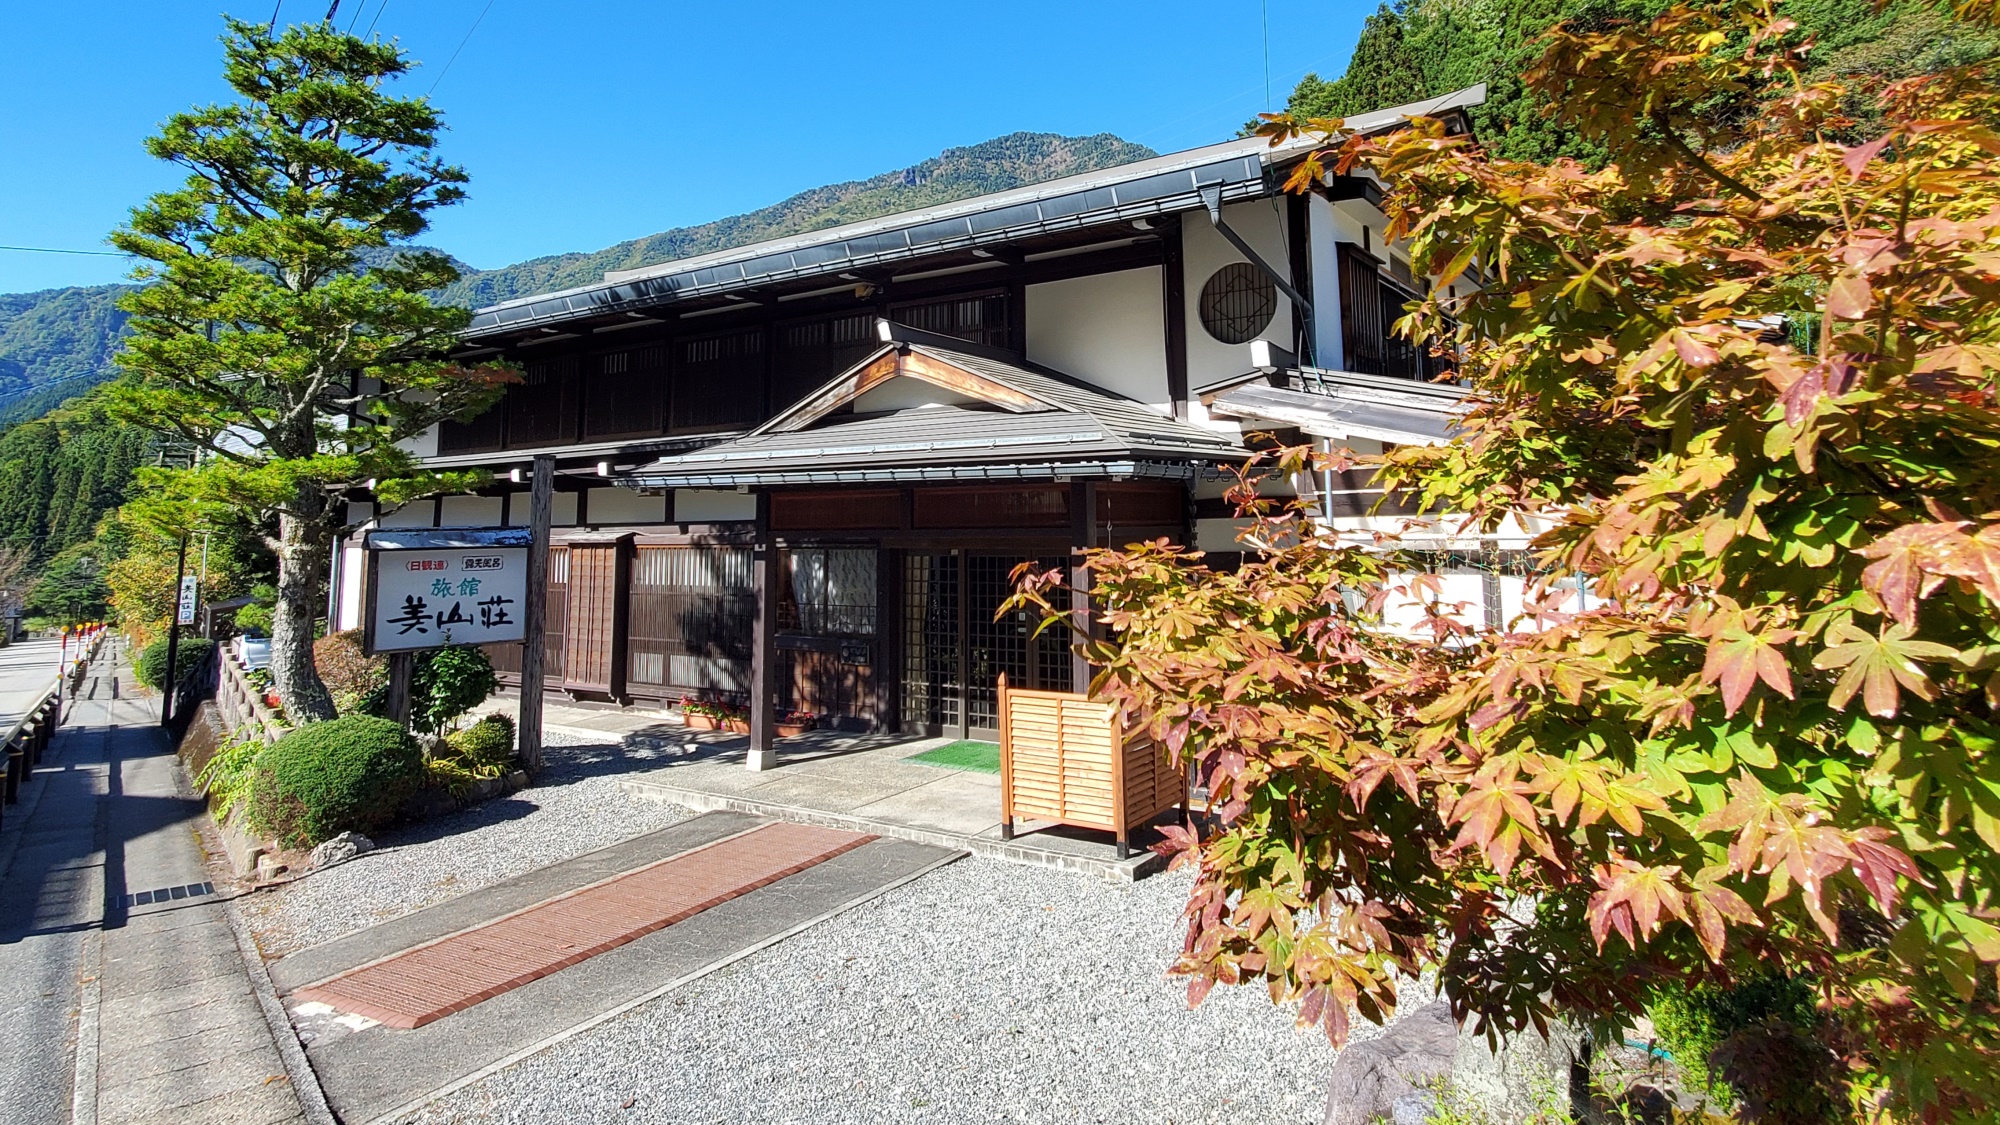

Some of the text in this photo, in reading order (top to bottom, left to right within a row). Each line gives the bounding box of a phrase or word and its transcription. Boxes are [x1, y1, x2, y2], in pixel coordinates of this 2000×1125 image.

[180, 584, 194, 609] 美山荘
[431, 577, 482, 598] 旅館
[386, 595, 515, 635] 美山荘
